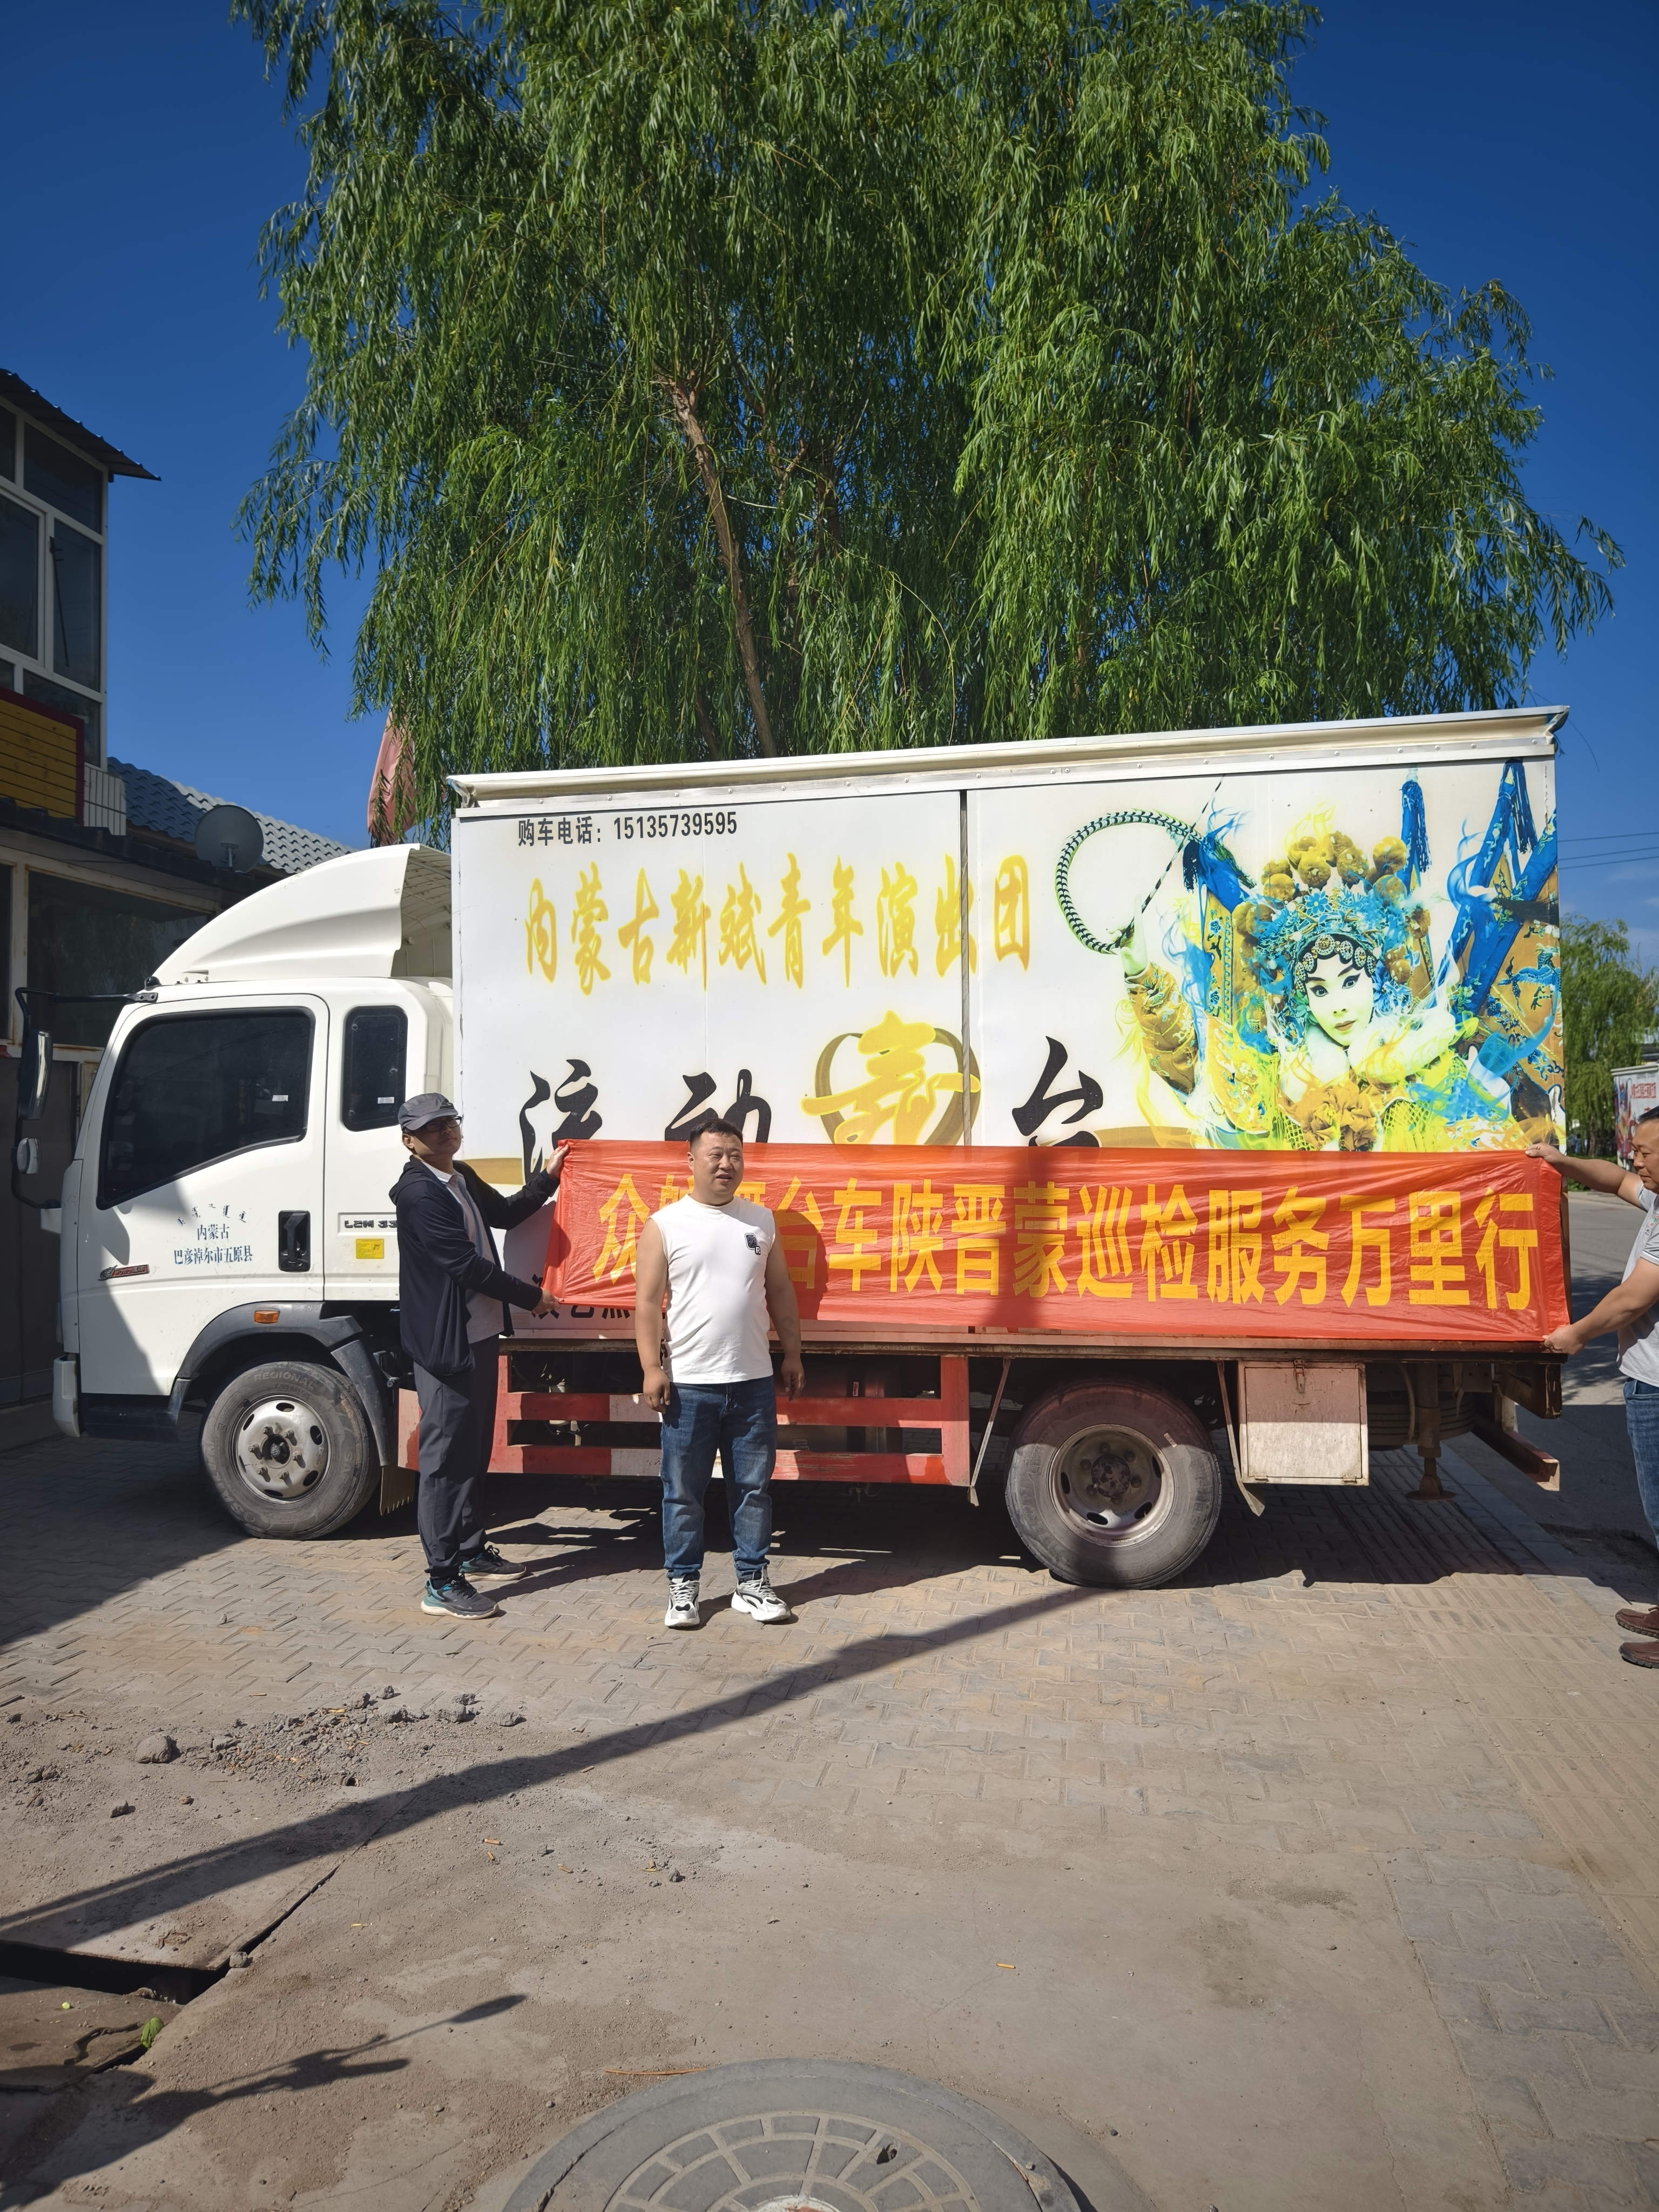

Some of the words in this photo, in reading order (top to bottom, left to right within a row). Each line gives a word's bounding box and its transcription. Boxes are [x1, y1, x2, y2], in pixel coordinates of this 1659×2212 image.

[614, 812, 737, 840] 15135739595
[197, 1223, 230, 1240] 内蒙古
[592, 1173, 1539, 1310] 众台车陕晋蒙巡检服务万里行
[174, 1245, 253, 1265] 巴彦淖尔市五原县
